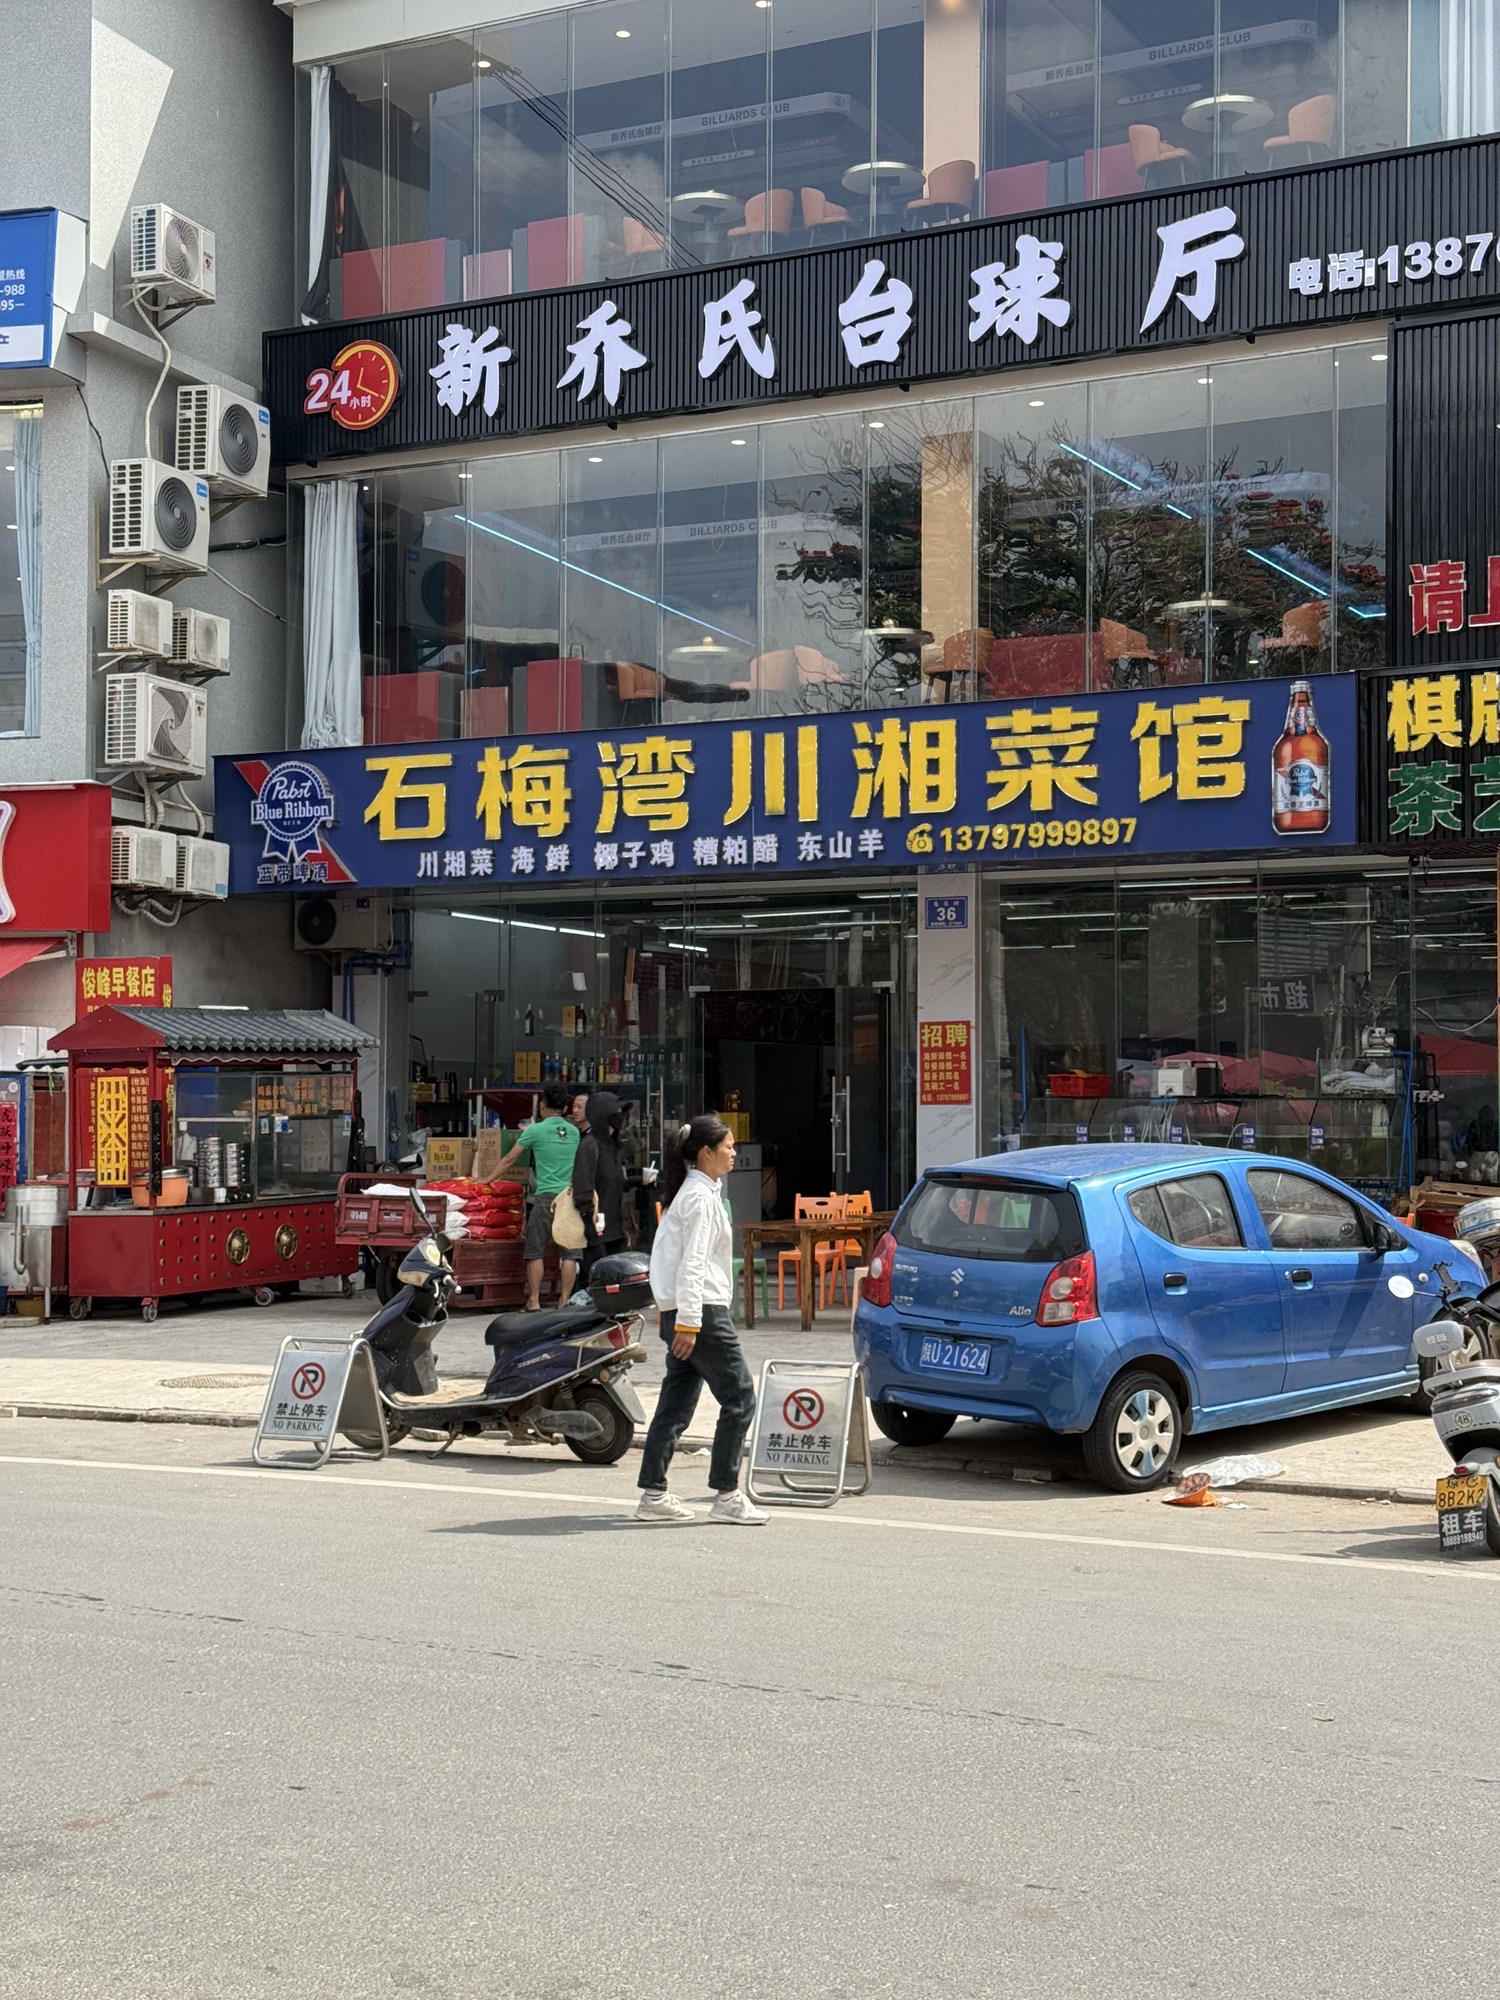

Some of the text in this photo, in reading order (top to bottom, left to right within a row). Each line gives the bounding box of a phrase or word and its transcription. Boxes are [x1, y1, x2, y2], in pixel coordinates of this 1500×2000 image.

[1148, 39, 1213, 61] BILLIARDS
[701, 108, 757, 127] BILLIARDS
[760, 102, 790, 116] CUB
[1289, 233, 1500, 296] 电话:1387
[428, 206, 1246, 418] 新乔氏台球厅
[690, 521, 745, 537] BILLIARDS
[363, 695, 1251, 843] 石梅湾川湘菜馆
[271, 776, 312, 801] Pabst
[255, 800, 330, 821] Blue Ribbon
[939, 817, 1137, 852] 13797999897
[417, 848, 494, 878] 川湘菜
[594, 838, 674, 870] 椰子鸡
[797, 828, 884, 862] 东山羊
[257, 861, 328, 884] 蓝带啤酒
[936, 907, 957, 921] 36
[82, 965, 155, 1000] 俊峰早餐店
[921, 1023, 968, 1048] 招聘
[275, 1401, 328, 1418] 禁止停车
[272, 1420, 324, 1432] NO PARKING
[767, 1432, 832, 1451] 禁止停车
[765, 1451, 830, 1466] NO PARKING
[1440, 1509, 1483, 1536] 租车
